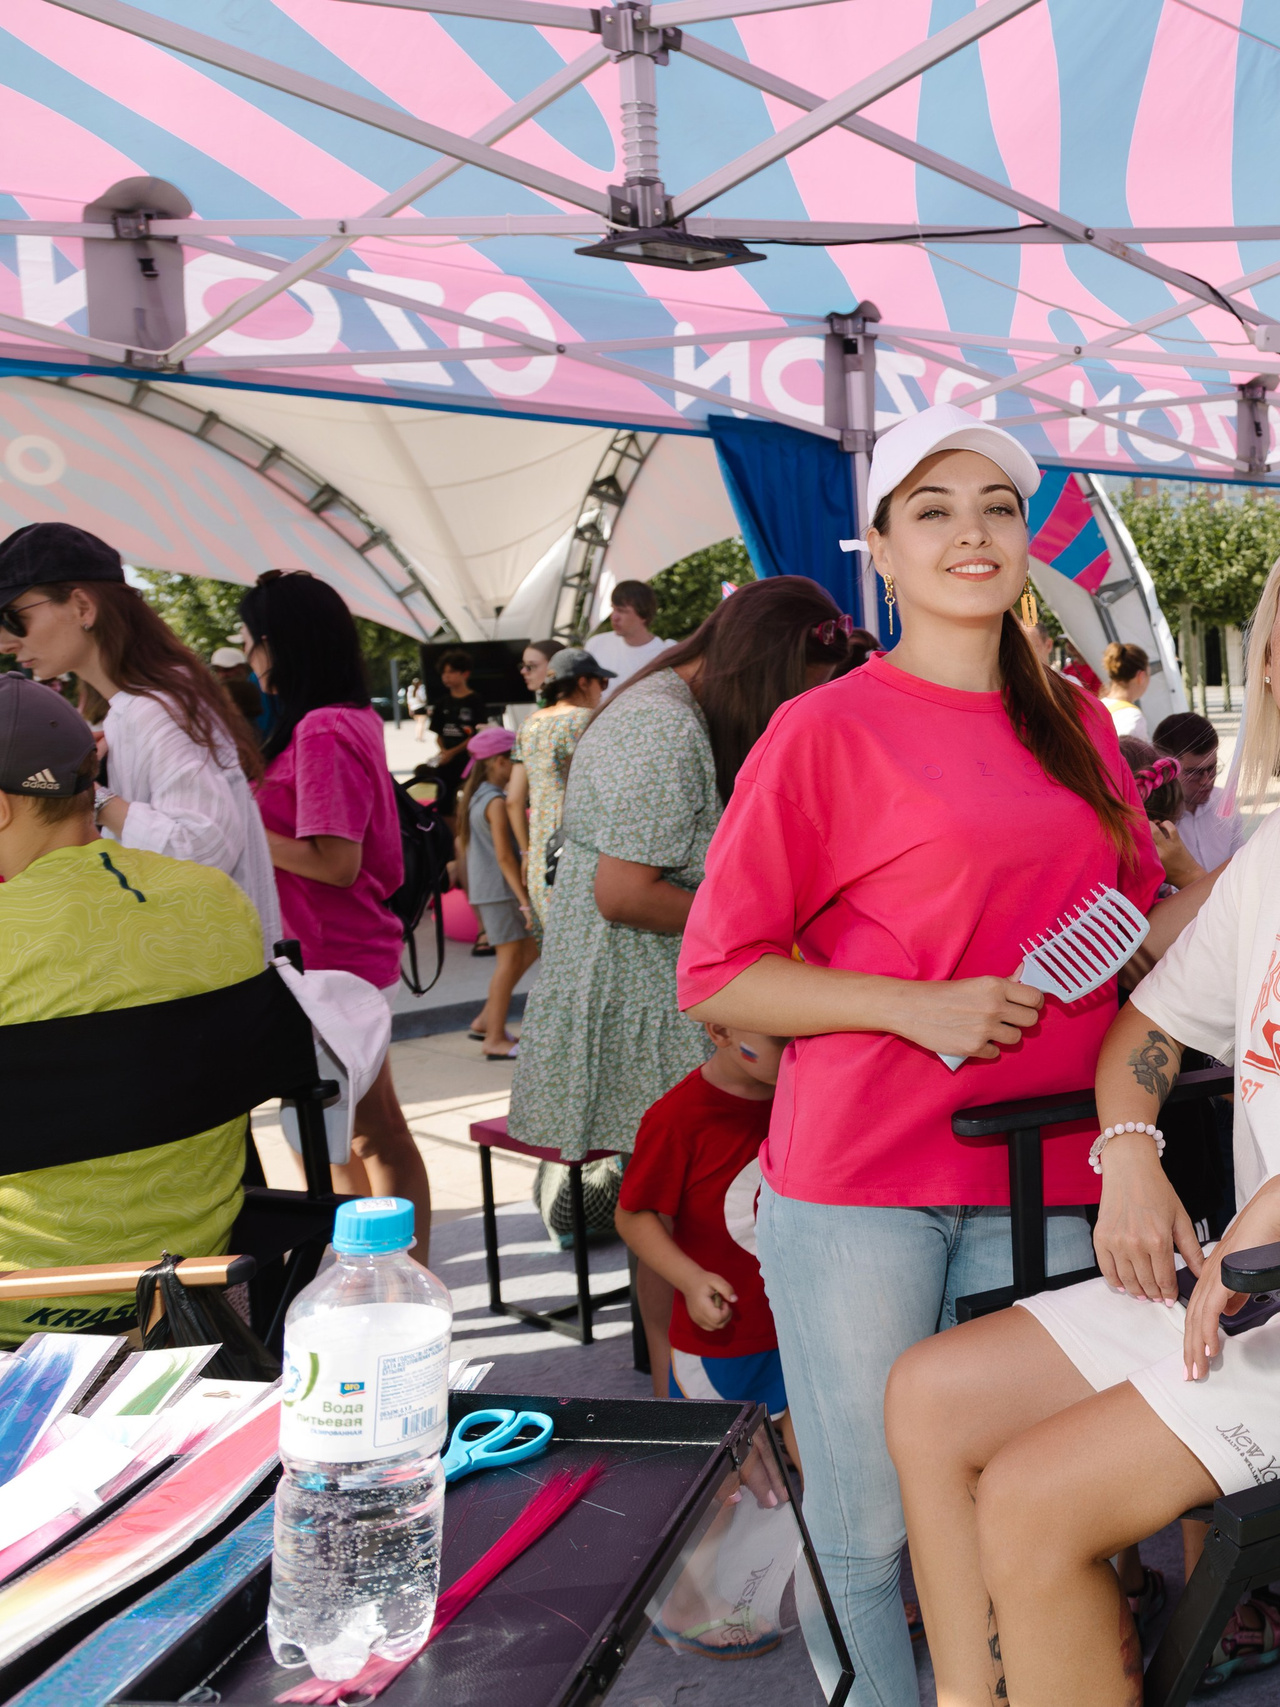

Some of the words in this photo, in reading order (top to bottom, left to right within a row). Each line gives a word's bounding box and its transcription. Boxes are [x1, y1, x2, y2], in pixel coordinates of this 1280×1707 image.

[21, 779, 61, 791] adidas
[1240, 1076, 1264, 1104] ST
[22, 1302, 138, 1328] KRAS
[322, 1401, 364, 1415] Вода
[296, 1412, 364, 1428] питьевая
[1215, 1422, 1266, 1457] New
[1220, 1432, 1242, 1453] HEALTH
